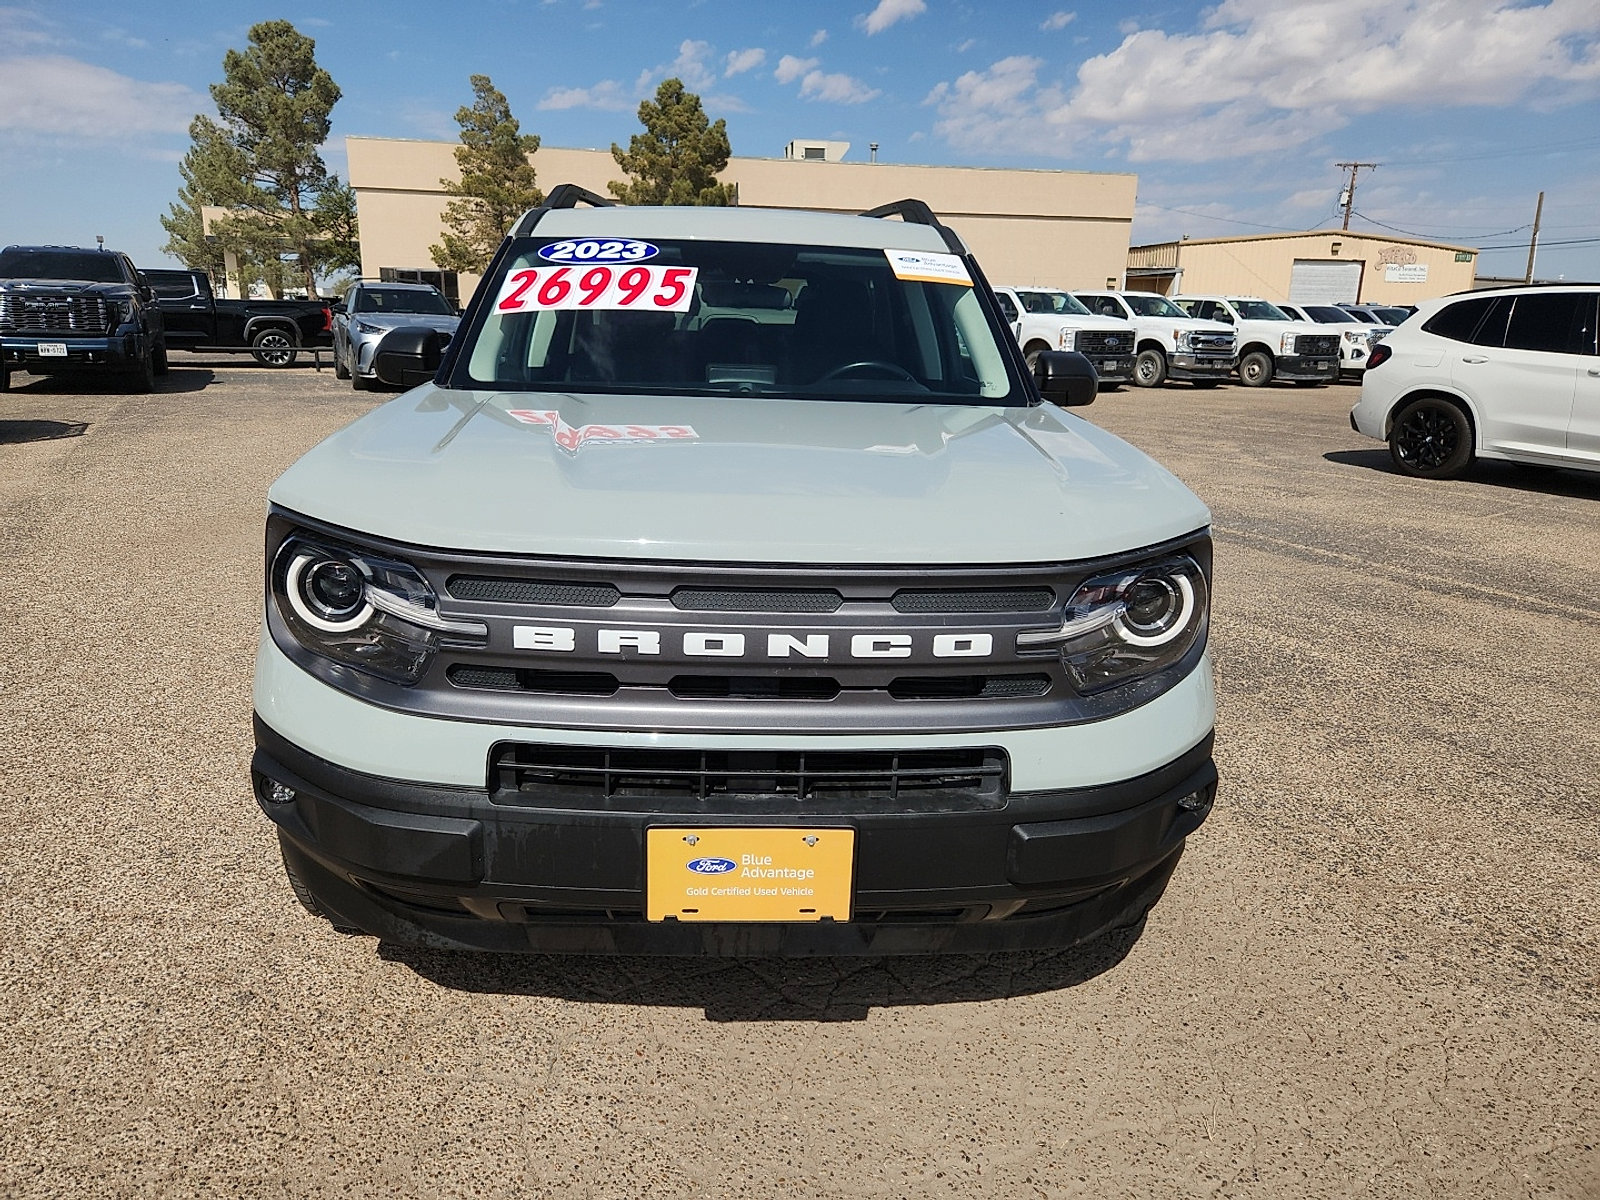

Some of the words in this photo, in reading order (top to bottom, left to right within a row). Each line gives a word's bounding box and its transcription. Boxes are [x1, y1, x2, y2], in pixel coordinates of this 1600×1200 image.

[550, 241, 648, 260] 2023
[498, 266, 693, 309] 26995
[512, 624, 993, 658] BRONCO
[694, 857, 731, 873] Ford
[741, 854, 772, 865] Blue
[741, 866, 815, 881] Advantage
[686, 887, 709, 896] Gold
[711, 887, 751, 896] Certified
[753, 887, 778, 896] Used
[780, 887, 814, 896] Vehicle
